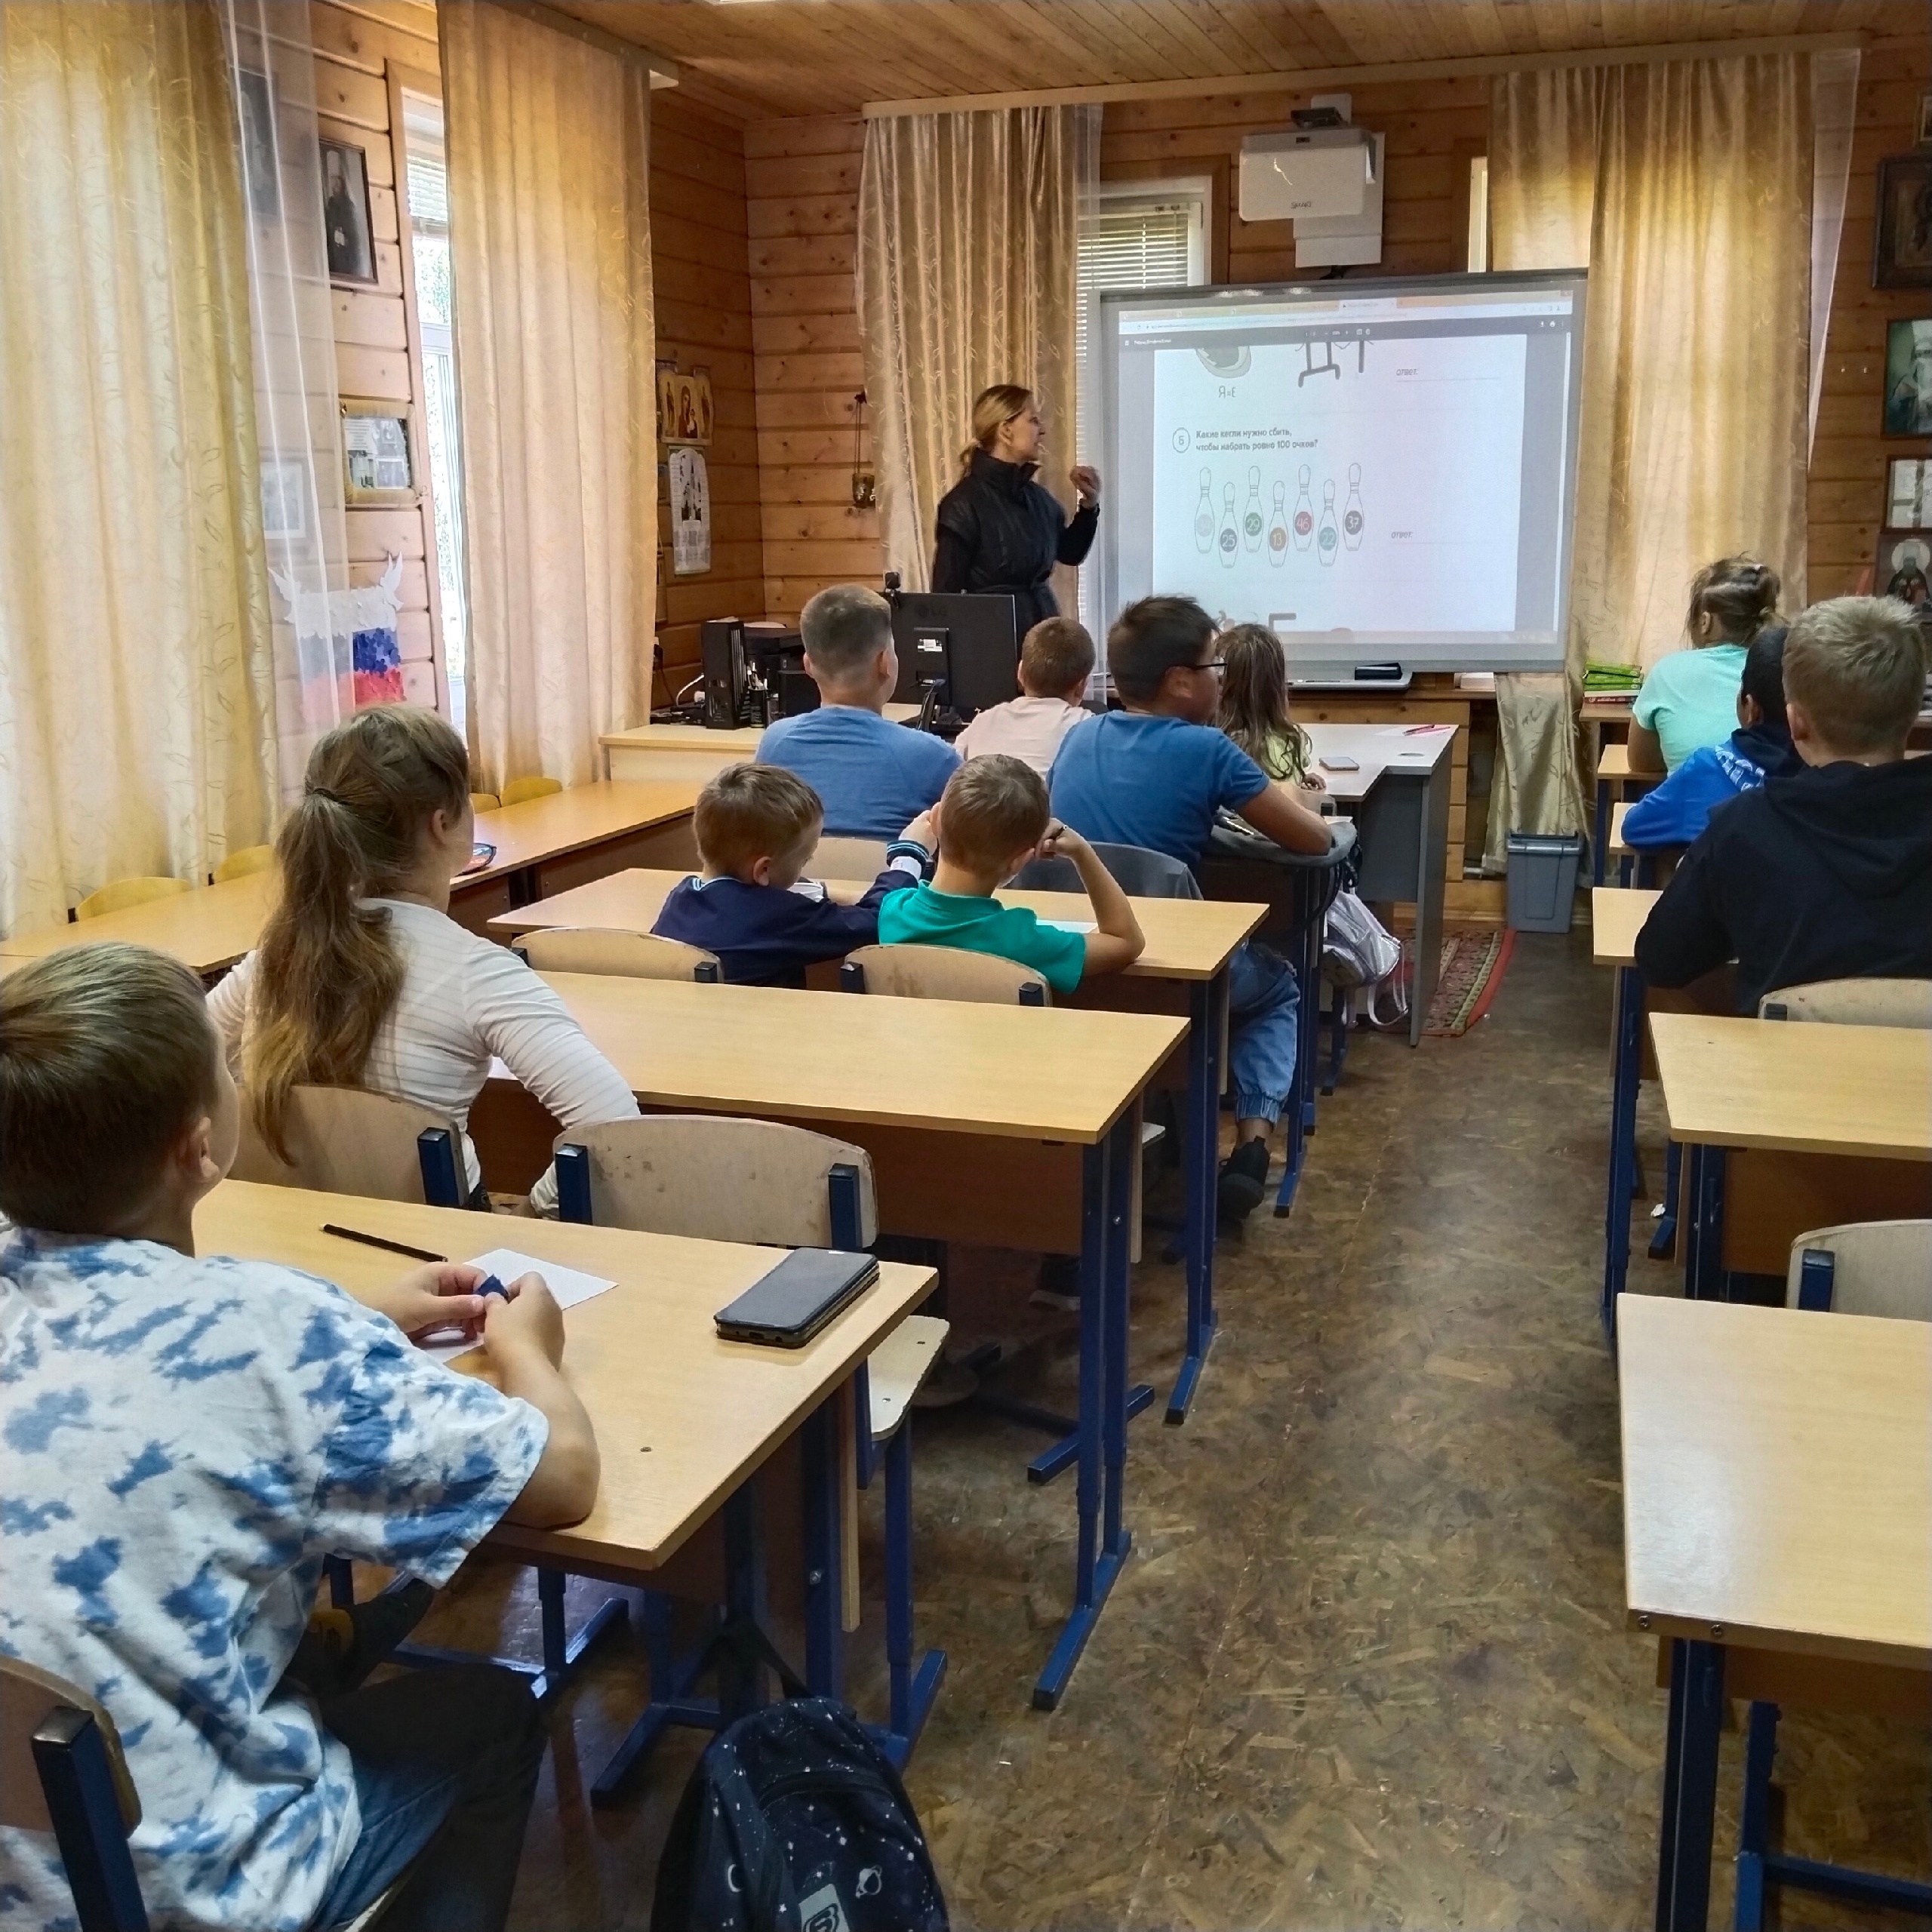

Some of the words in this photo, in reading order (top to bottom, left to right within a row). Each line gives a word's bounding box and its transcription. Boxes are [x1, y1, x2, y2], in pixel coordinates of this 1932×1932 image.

[1196, 429, 1219, 438] Какие
[1243, 429, 1267, 439] нужно
[1269, 427, 1292, 437] сбить,
[1195, 442, 1220, 451] чтобы
[1220, 441, 1251, 452] набрать
[1252, 442, 1275, 451] ровно
[1277, 440, 1290, 449] 100
[1292, 439, 1318, 449] очков?
[1247, 519, 1260, 531] 29
[1297, 518, 1309, 529] 46
[1348, 516, 1358, 528] 37
[1222, 535, 1235, 547] 25
[1272, 534, 1282, 546] 13
[1322, 534, 1335, 546] 22
